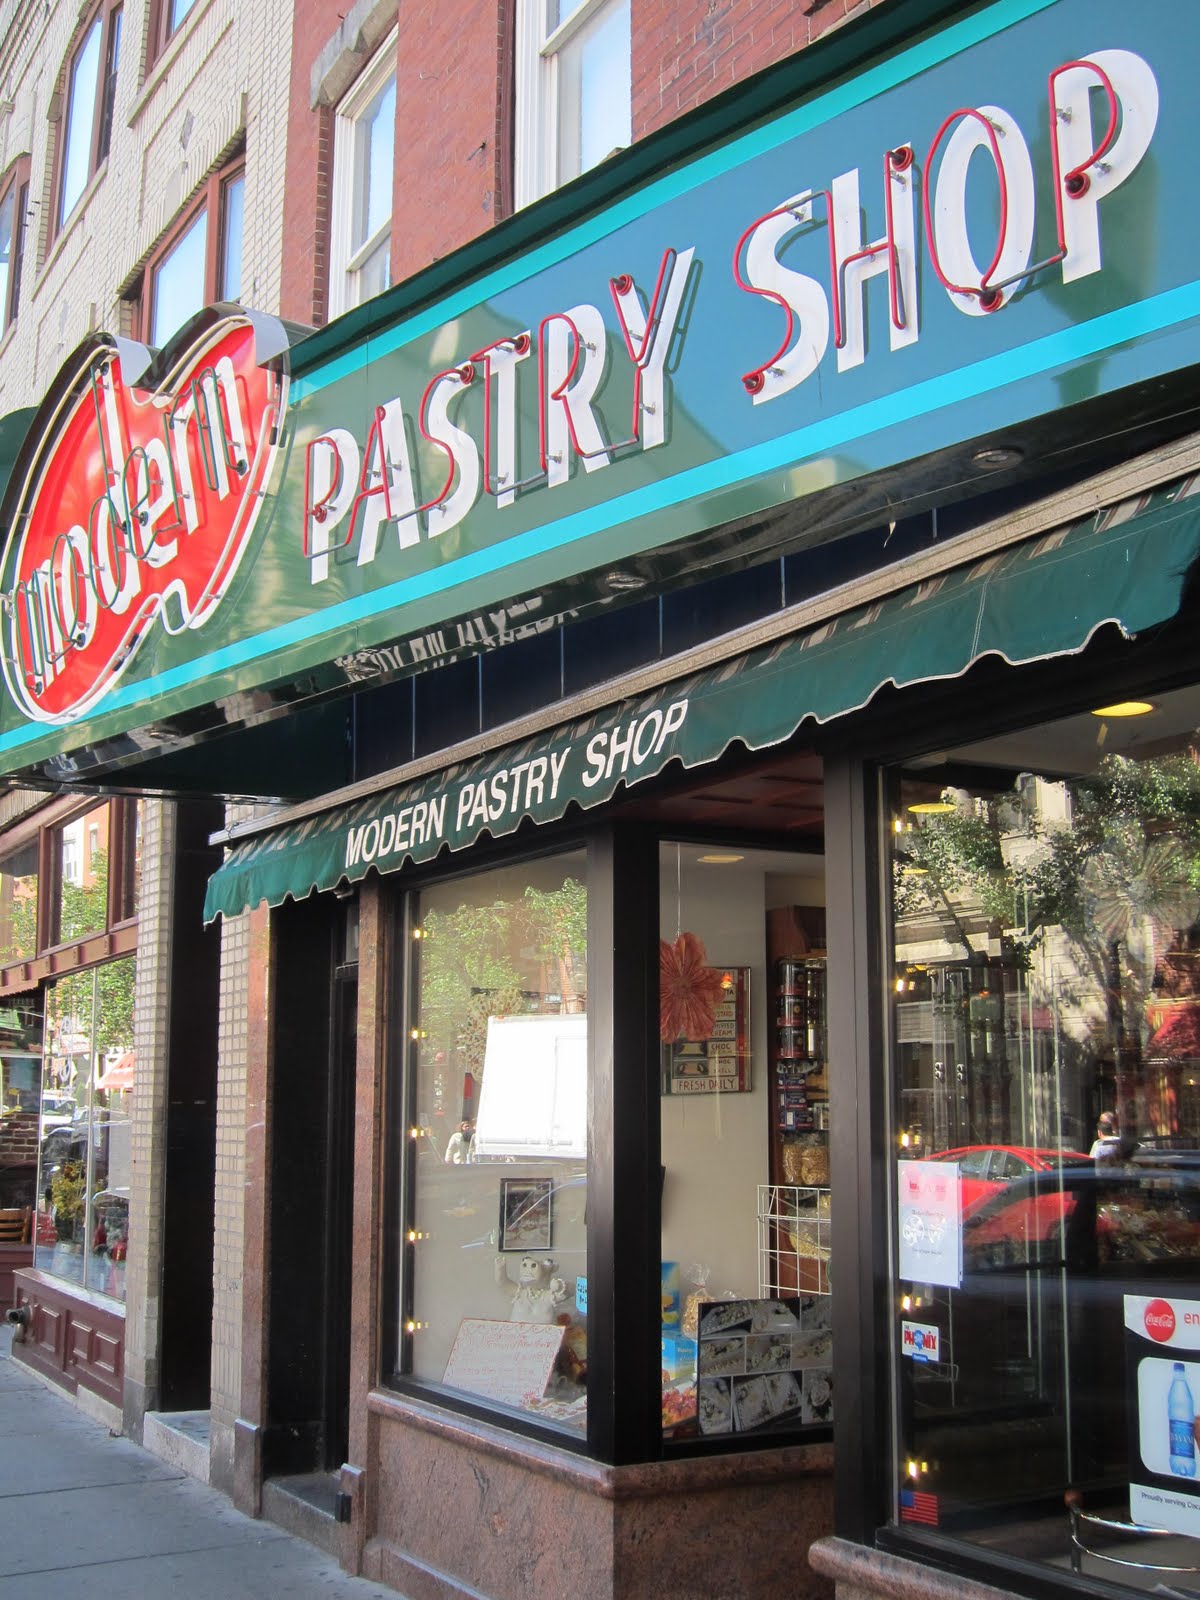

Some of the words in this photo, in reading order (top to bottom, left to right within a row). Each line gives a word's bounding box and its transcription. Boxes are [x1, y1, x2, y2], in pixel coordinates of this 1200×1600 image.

[304, 245, 697, 585] PASTRY
[734, 48, 1160, 406] SHOP
[345, 793, 447, 868] MODERN
[456, 746, 571, 832] PASTRY
[582, 699, 689, 788] SHOP
[679, 1080, 705, 1091] FRESH
[708, 1078, 735, 1090] DAILY
[1145, 1312, 1174, 1328] Coca-Cola
[1141, 1491, 1163, 1503] Proudly
[1165, 1497, 1186, 1509] serving
